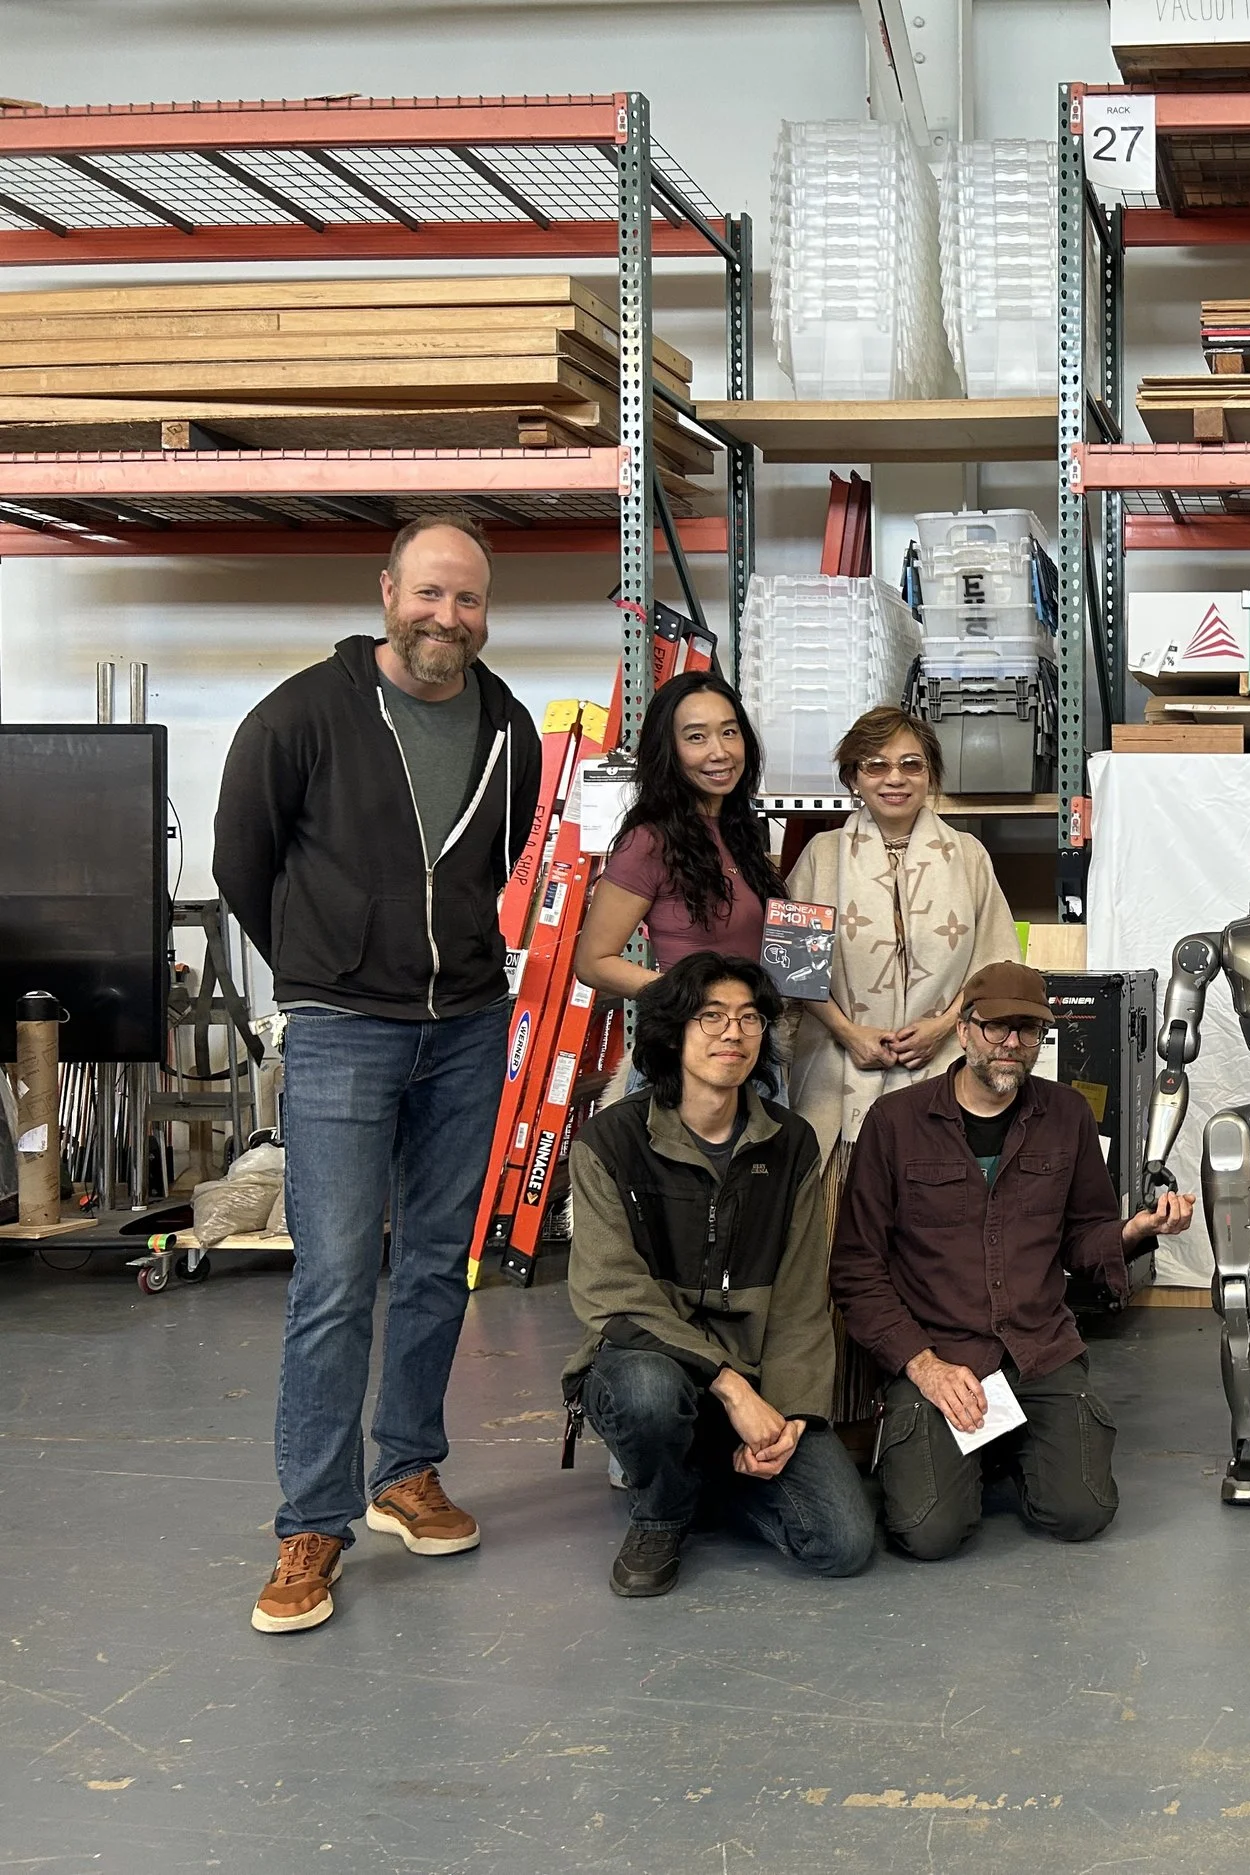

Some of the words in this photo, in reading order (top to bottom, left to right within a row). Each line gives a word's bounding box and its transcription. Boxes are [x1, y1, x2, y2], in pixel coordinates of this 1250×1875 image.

[1106, 106, 1130, 114] RACK
[1092, 125, 1144, 162] 27
[514, 855, 533, 886] SHOP
[769, 910, 808, 925] PM01
[771, 902, 817, 915] ENGINEAI
[1048, 995, 1095, 1005] ENGINEAI
[512, 1025, 528, 1068] WERNER
[528, 1130, 556, 1191] PINNACLE
